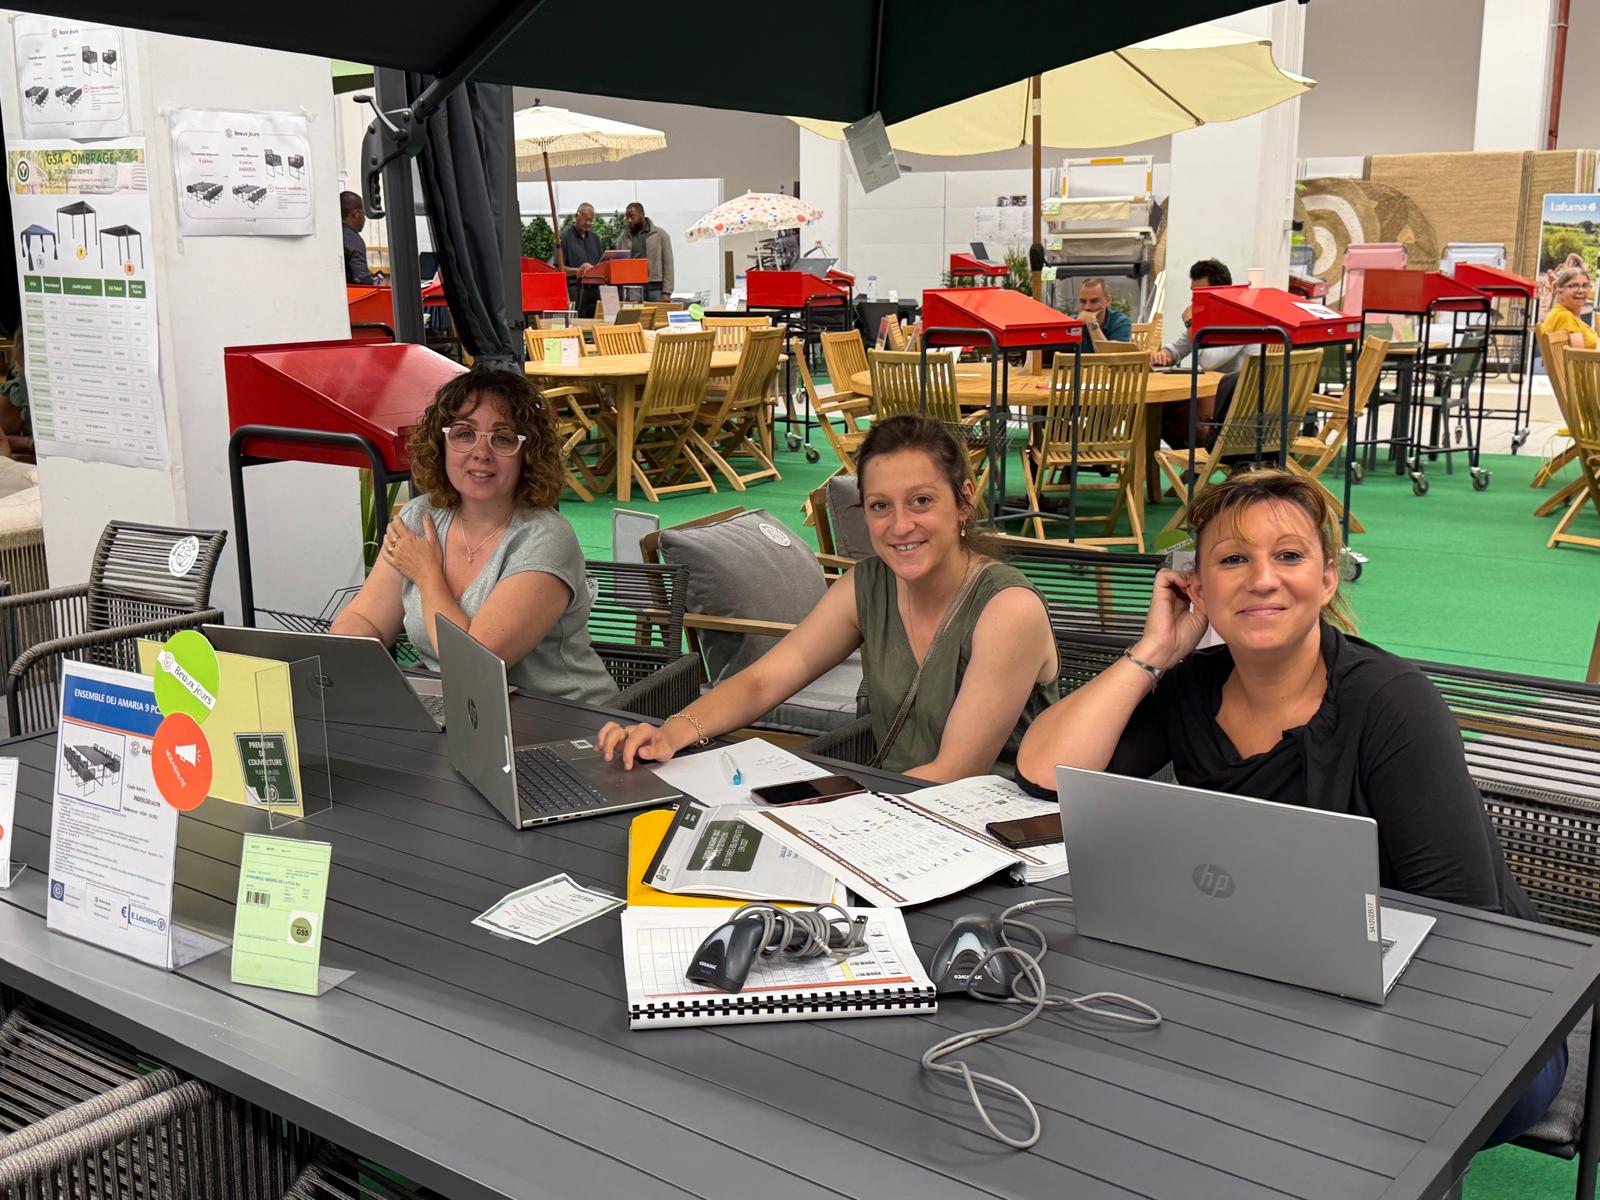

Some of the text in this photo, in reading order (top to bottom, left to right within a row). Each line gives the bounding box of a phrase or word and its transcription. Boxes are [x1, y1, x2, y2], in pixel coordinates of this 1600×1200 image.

[46, 153, 63, 165] GSA
[71, 153, 116, 165] OMBRAGE
[1551, 201, 1588, 212] Lafuma
[174, 664, 213, 706] Beaux jours
[74, 687, 105, 704] ENSEMBLE
[105, 696, 117, 707] DEJ
[117, 698, 144, 713] AMARIA
[144, 703, 150, 713] 9
[248, 741, 275, 749] PREMERE
[1199, 864, 1230, 897] hp
[131, 911, 159, 927] E.Leclerc
[296, 928, 309, 937] GSS
